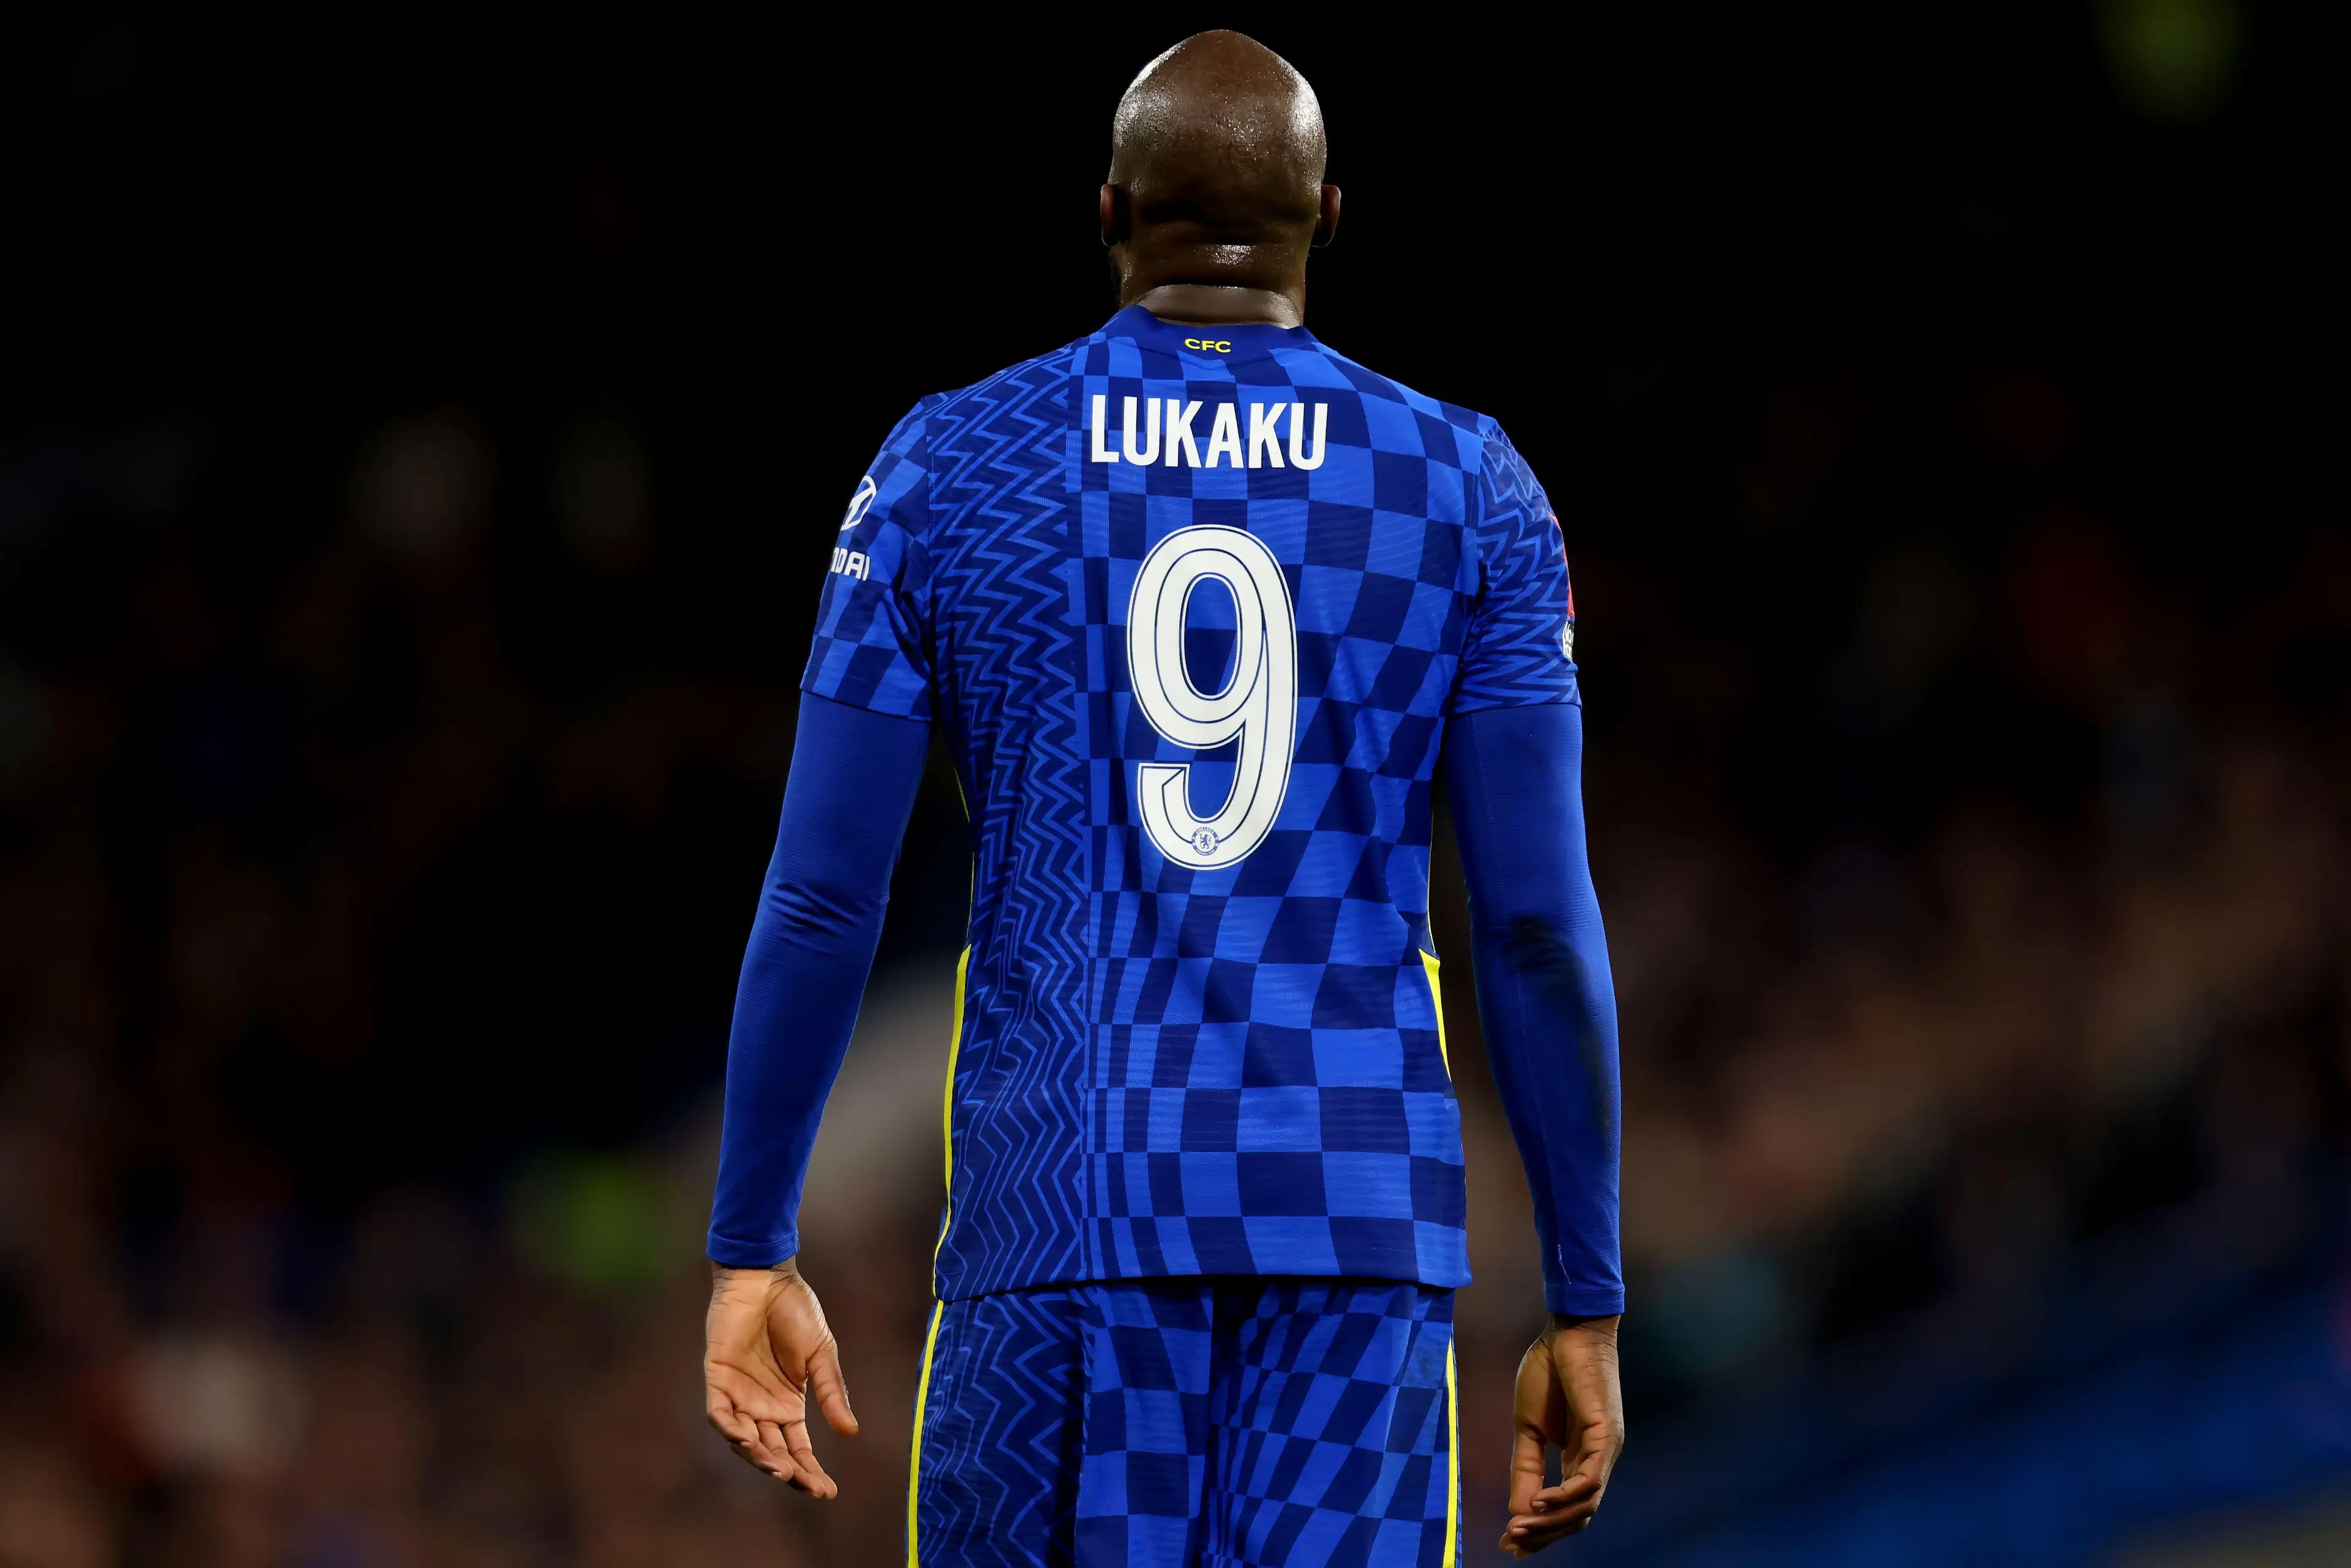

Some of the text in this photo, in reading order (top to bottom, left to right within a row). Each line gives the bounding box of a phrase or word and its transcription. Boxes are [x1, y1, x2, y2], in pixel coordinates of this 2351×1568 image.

[1184, 338, 1231, 353] CFC
[1091, 394, 1328, 470] LUKAKU
[1127, 523, 1298, 871] 9
